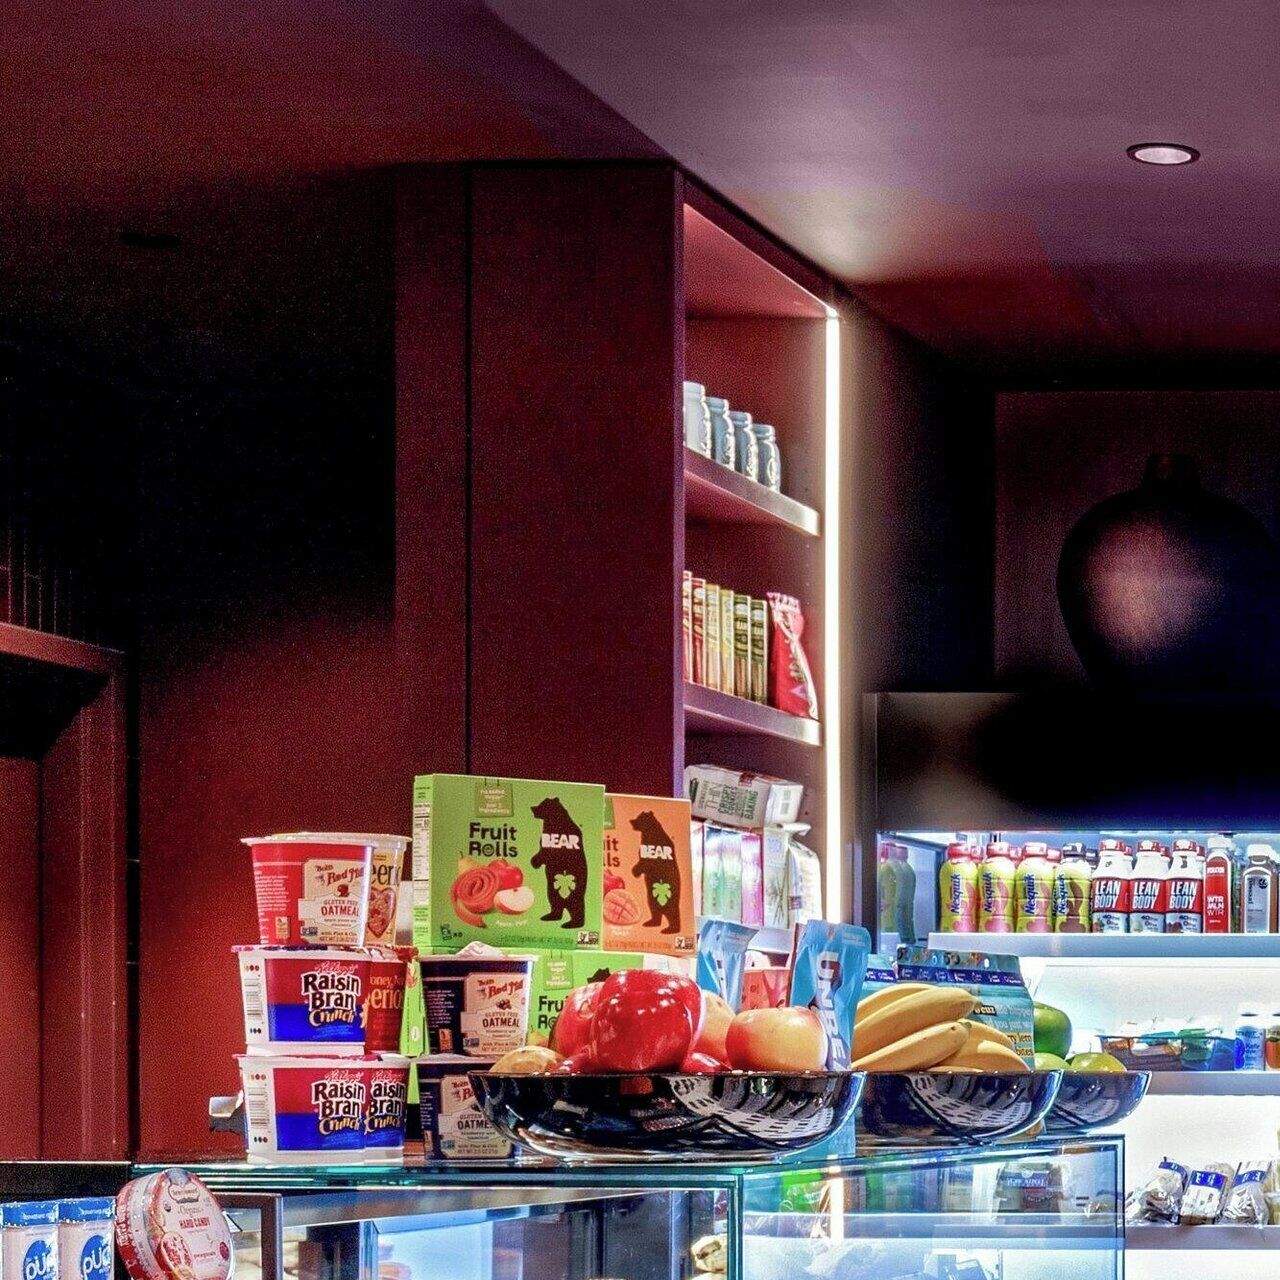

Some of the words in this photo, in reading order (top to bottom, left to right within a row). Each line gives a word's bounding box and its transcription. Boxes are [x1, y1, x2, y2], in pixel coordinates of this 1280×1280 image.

[470, 823, 516, 841] Fruit
[469, 841, 518, 857] Rolls
[542, 834, 580, 849] BEAR
[640, 845, 674, 860] BEAR
[951, 874, 961, 914] Nesquik
[1096, 881, 1121, 896] LEAN
[1134, 881, 1159, 896] LEAN
[1170, 881, 1196, 896] LEAN
[302, 974, 360, 993] Raisin
[309, 992, 356, 1010] Bran
[312, 1083, 365, 1102] Raisin
